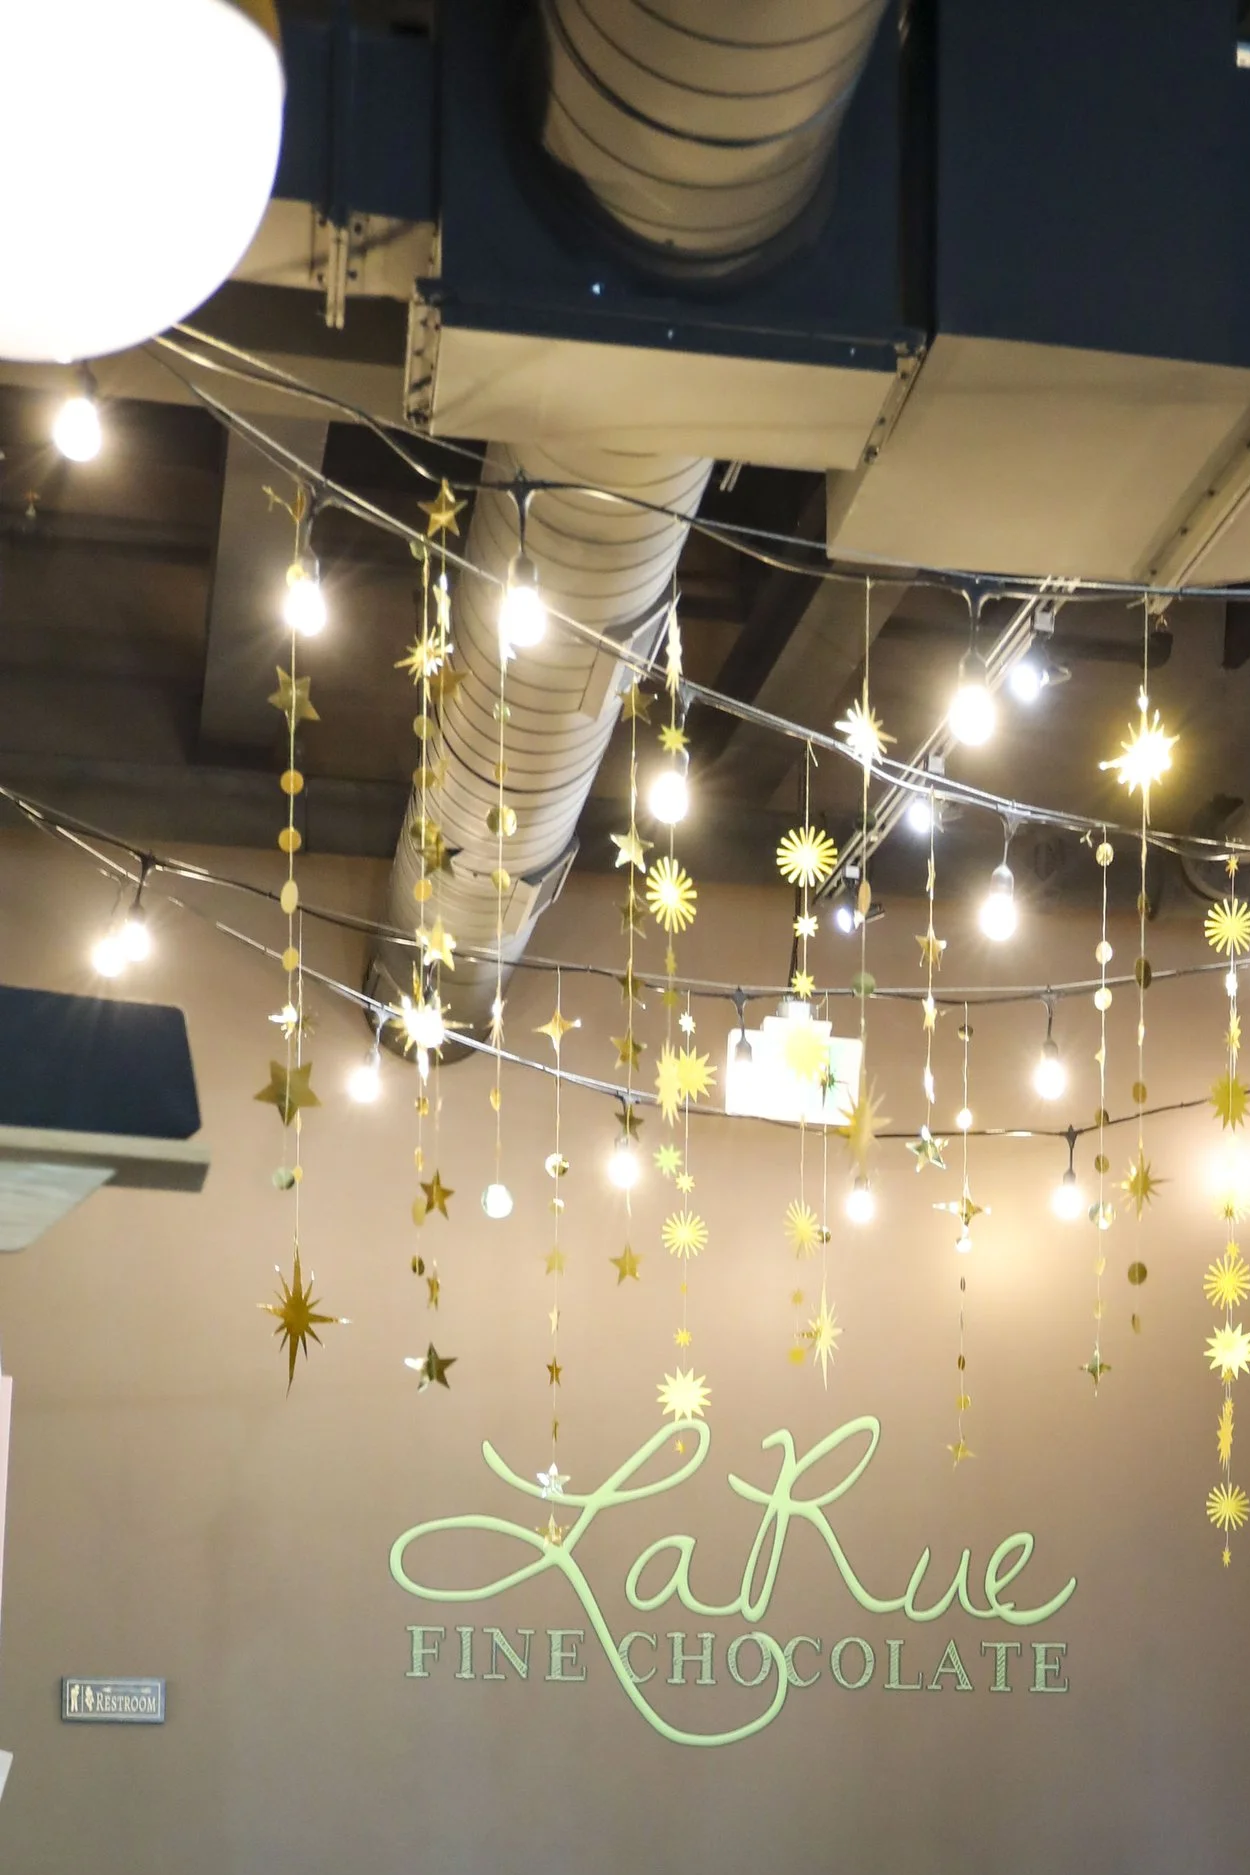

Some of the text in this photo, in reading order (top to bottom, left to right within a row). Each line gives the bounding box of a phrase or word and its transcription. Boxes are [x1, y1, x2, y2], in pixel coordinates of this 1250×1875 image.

[405, 1624, 1070, 1693] FINE CHOCOLATE
[96, 1692, 156, 1713] RESTROOM
